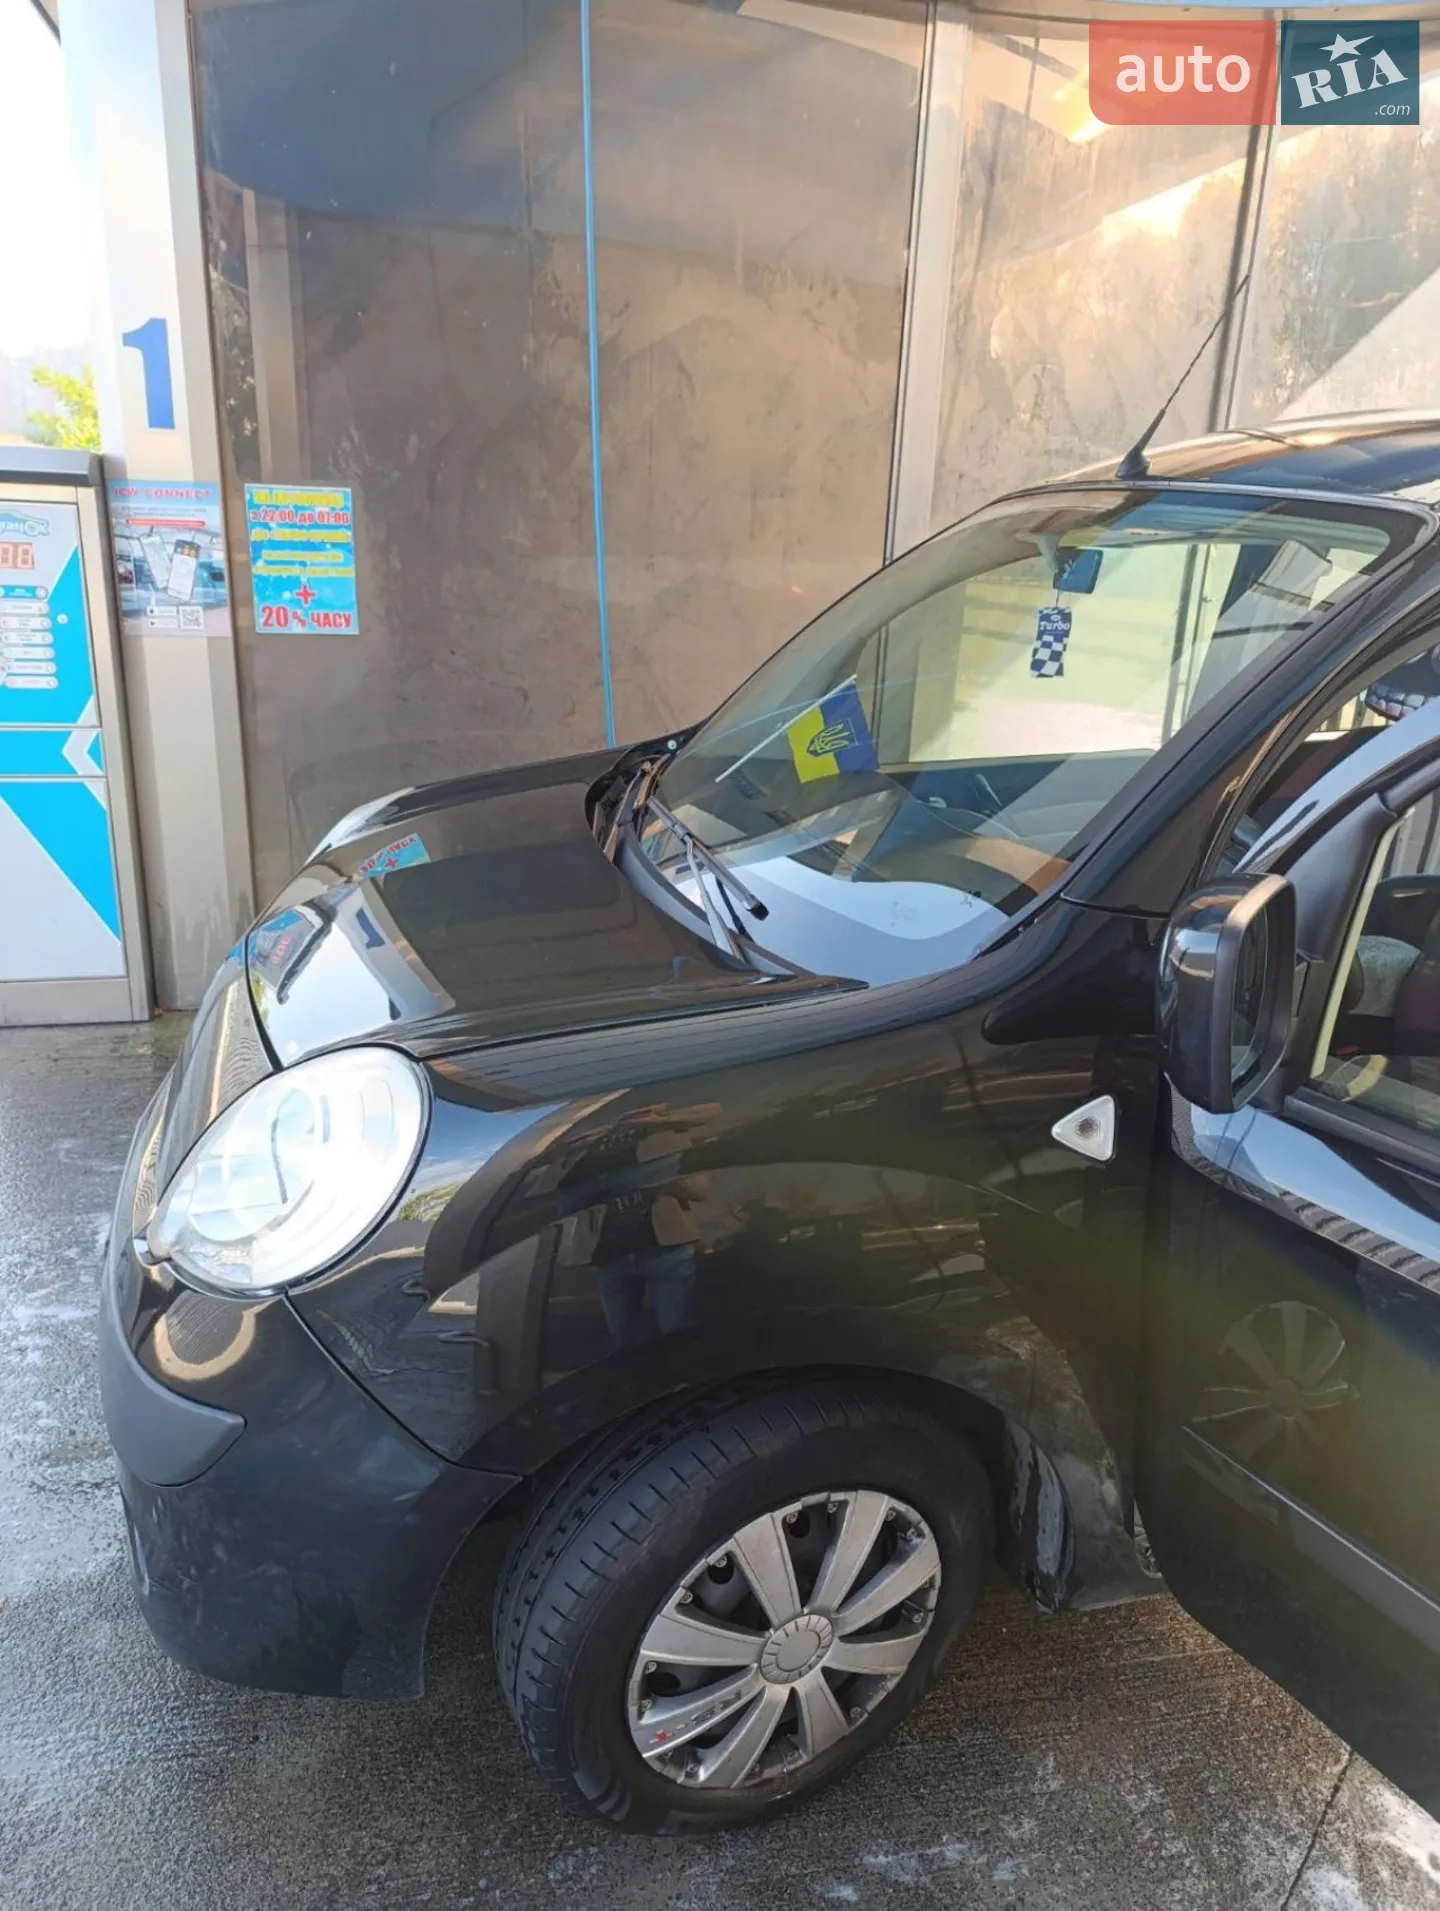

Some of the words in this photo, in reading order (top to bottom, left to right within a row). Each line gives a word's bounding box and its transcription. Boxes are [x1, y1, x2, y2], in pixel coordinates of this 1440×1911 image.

[121, 317, 176, 430] 1
[145, 488, 211, 500] CONNECT
[261, 508, 295, 522] 22:00
[298, 511, 315, 524] до
[261, 605, 289, 628] 20
[292, 611, 307, 628] %
[310, 612, 352, 628] ЧАСУ
[1040, 620, 1070, 631] Turbo
